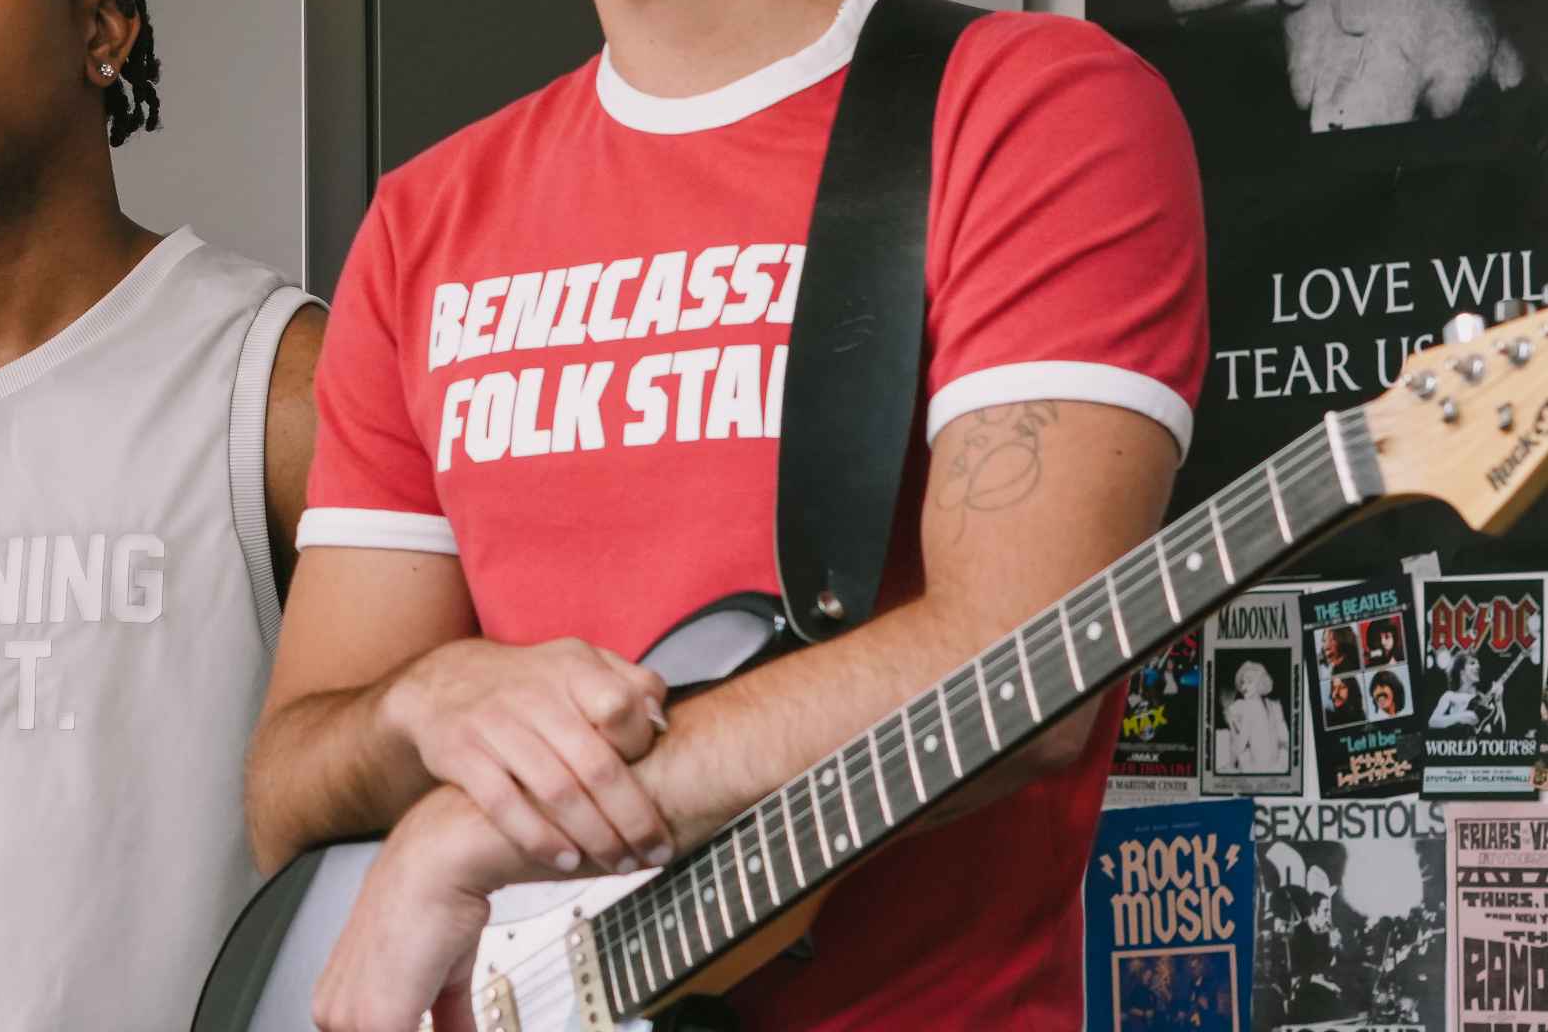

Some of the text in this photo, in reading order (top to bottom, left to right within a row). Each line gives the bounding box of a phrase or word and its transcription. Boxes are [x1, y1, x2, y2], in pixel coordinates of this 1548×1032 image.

[1271, 260, 1416, 324] LOVE
[1215, 341, 1363, 401] TEAR
[437, 360, 615, 473] FOLK
[1217, 602, 1289, 641] MADONNA
[1315, 588, 1398, 622] THE BEATLES
[1428, 592, 1542, 653] AC/DC
[1425, 738, 1478, 757] WORLD
[1254, 799, 1447, 841] SEX PISTOLS
[1459, 822, 1521, 850] FRIARS
[1119, 833, 1221, 893] ROCK
[1110, 885, 1236, 947] MUSIC
